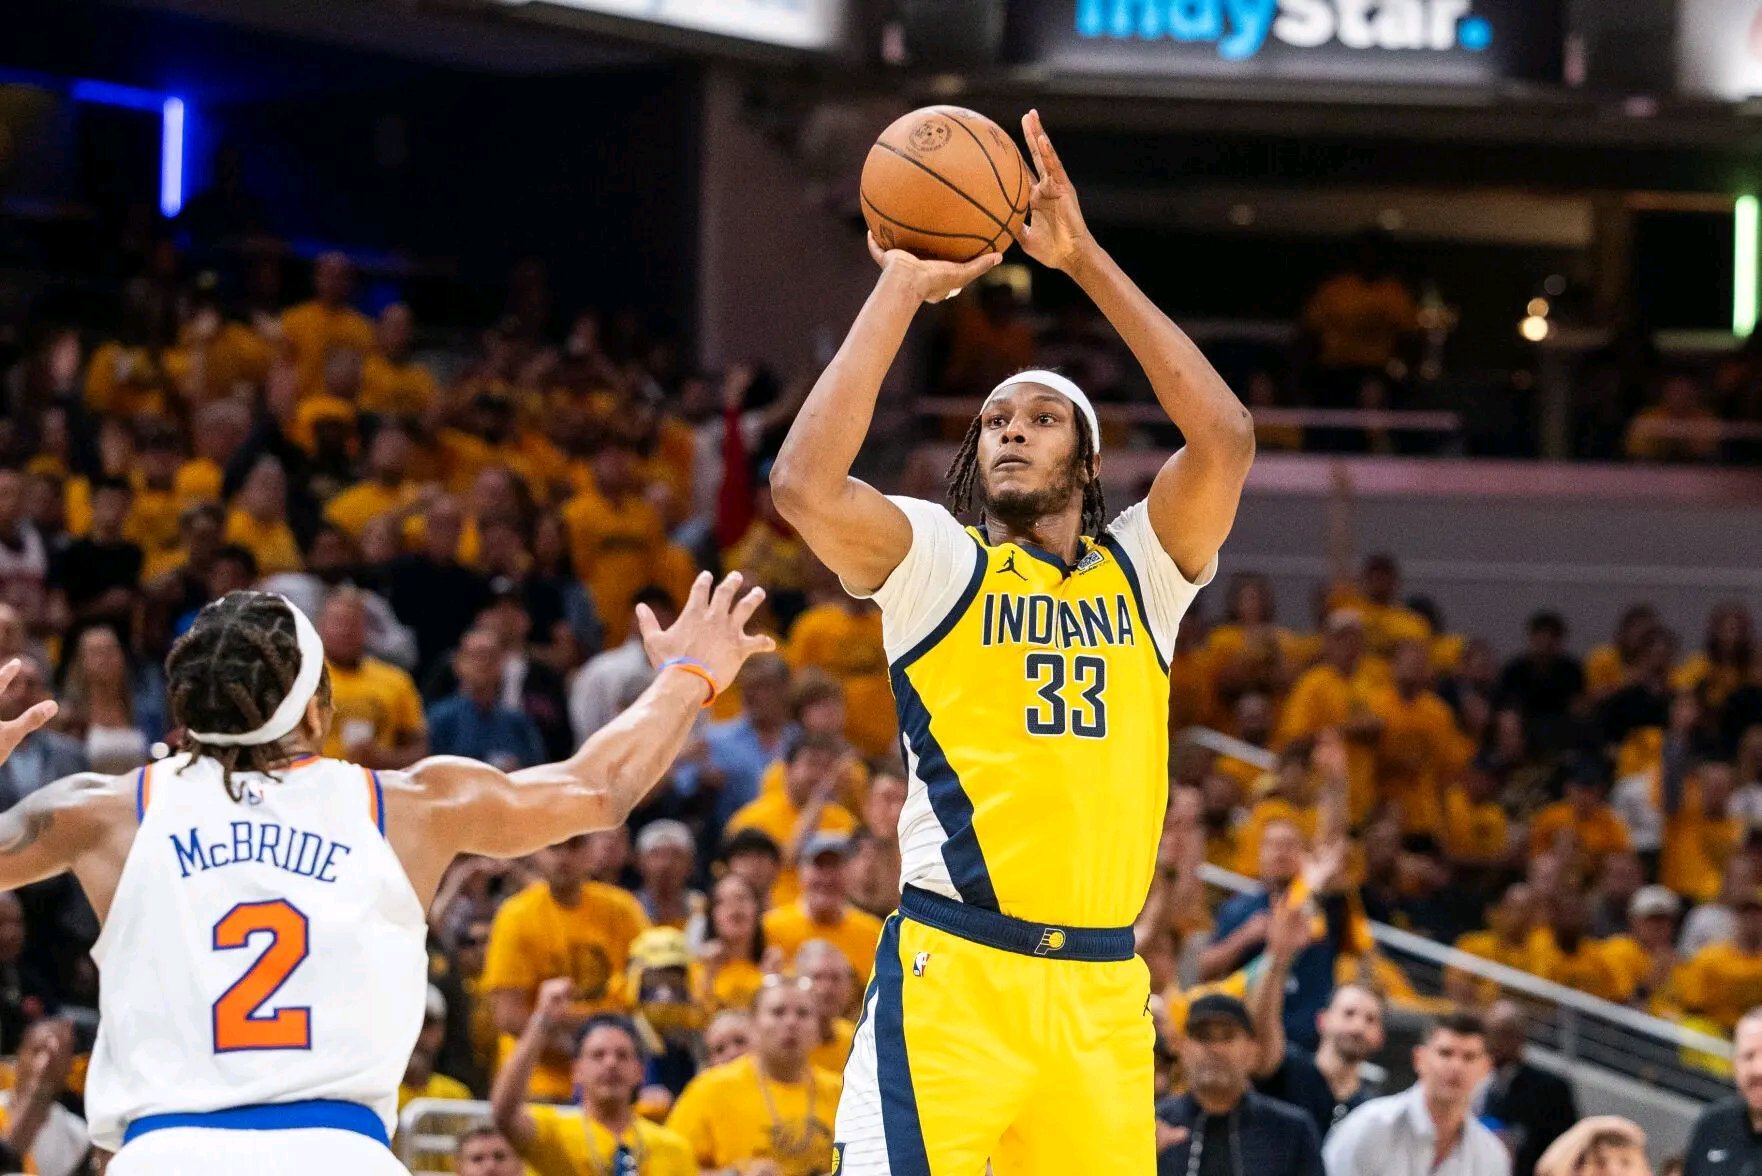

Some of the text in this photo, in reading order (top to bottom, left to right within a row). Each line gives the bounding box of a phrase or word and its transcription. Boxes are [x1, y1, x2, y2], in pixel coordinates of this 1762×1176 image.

[982, 593, 1134, 648] INDANA
[1025, 653, 1108, 739] 33
[169, 821, 352, 883] McBRIDE
[212, 898, 312, 1054] 2
